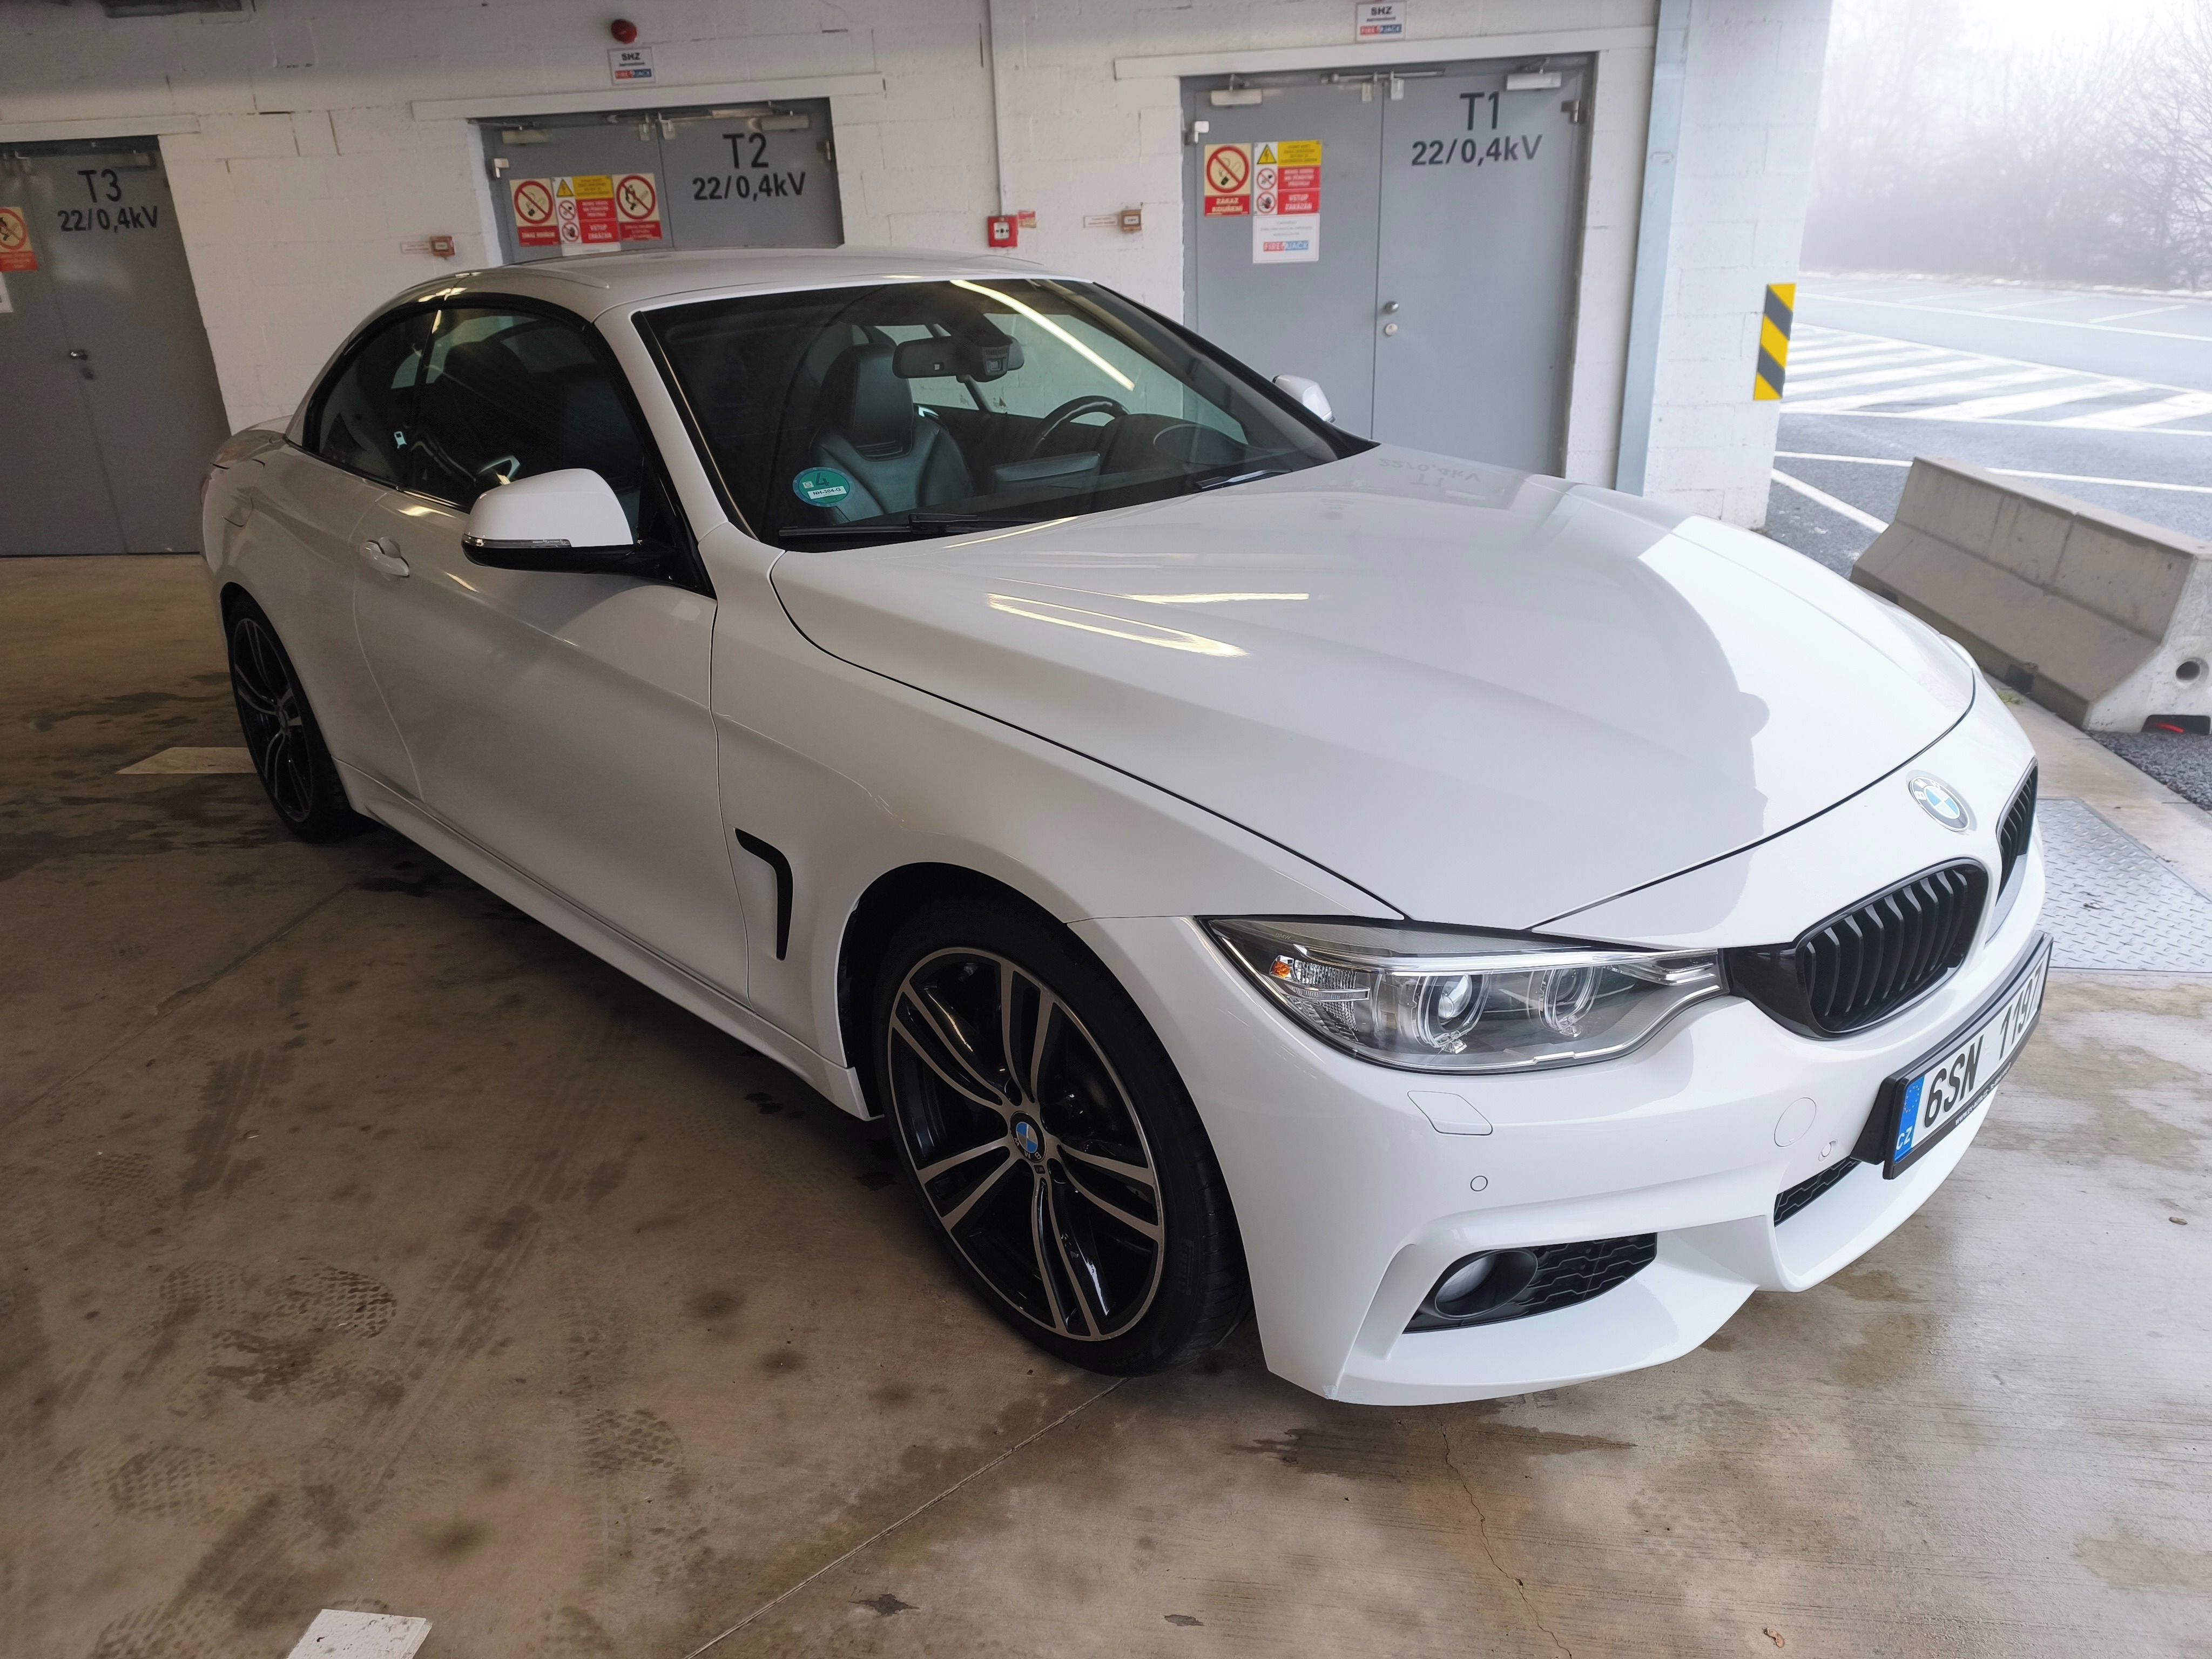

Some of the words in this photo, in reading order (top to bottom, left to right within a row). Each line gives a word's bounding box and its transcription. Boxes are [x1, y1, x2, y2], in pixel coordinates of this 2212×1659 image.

[1460, 91, 1500, 131] T1
[723, 132, 769, 168] T2
[1412, 134, 1543, 167] 22/0,4kV
[77, 168, 122, 203] T3
[692, 172, 806, 201] 22/0,4kV
[57, 206, 158, 233] 22/0,4kV
[815, 473, 830, 486] 4
[1924, 1034, 1984, 1128] 6SN
[1896, 1125, 1912, 1150] CZ
